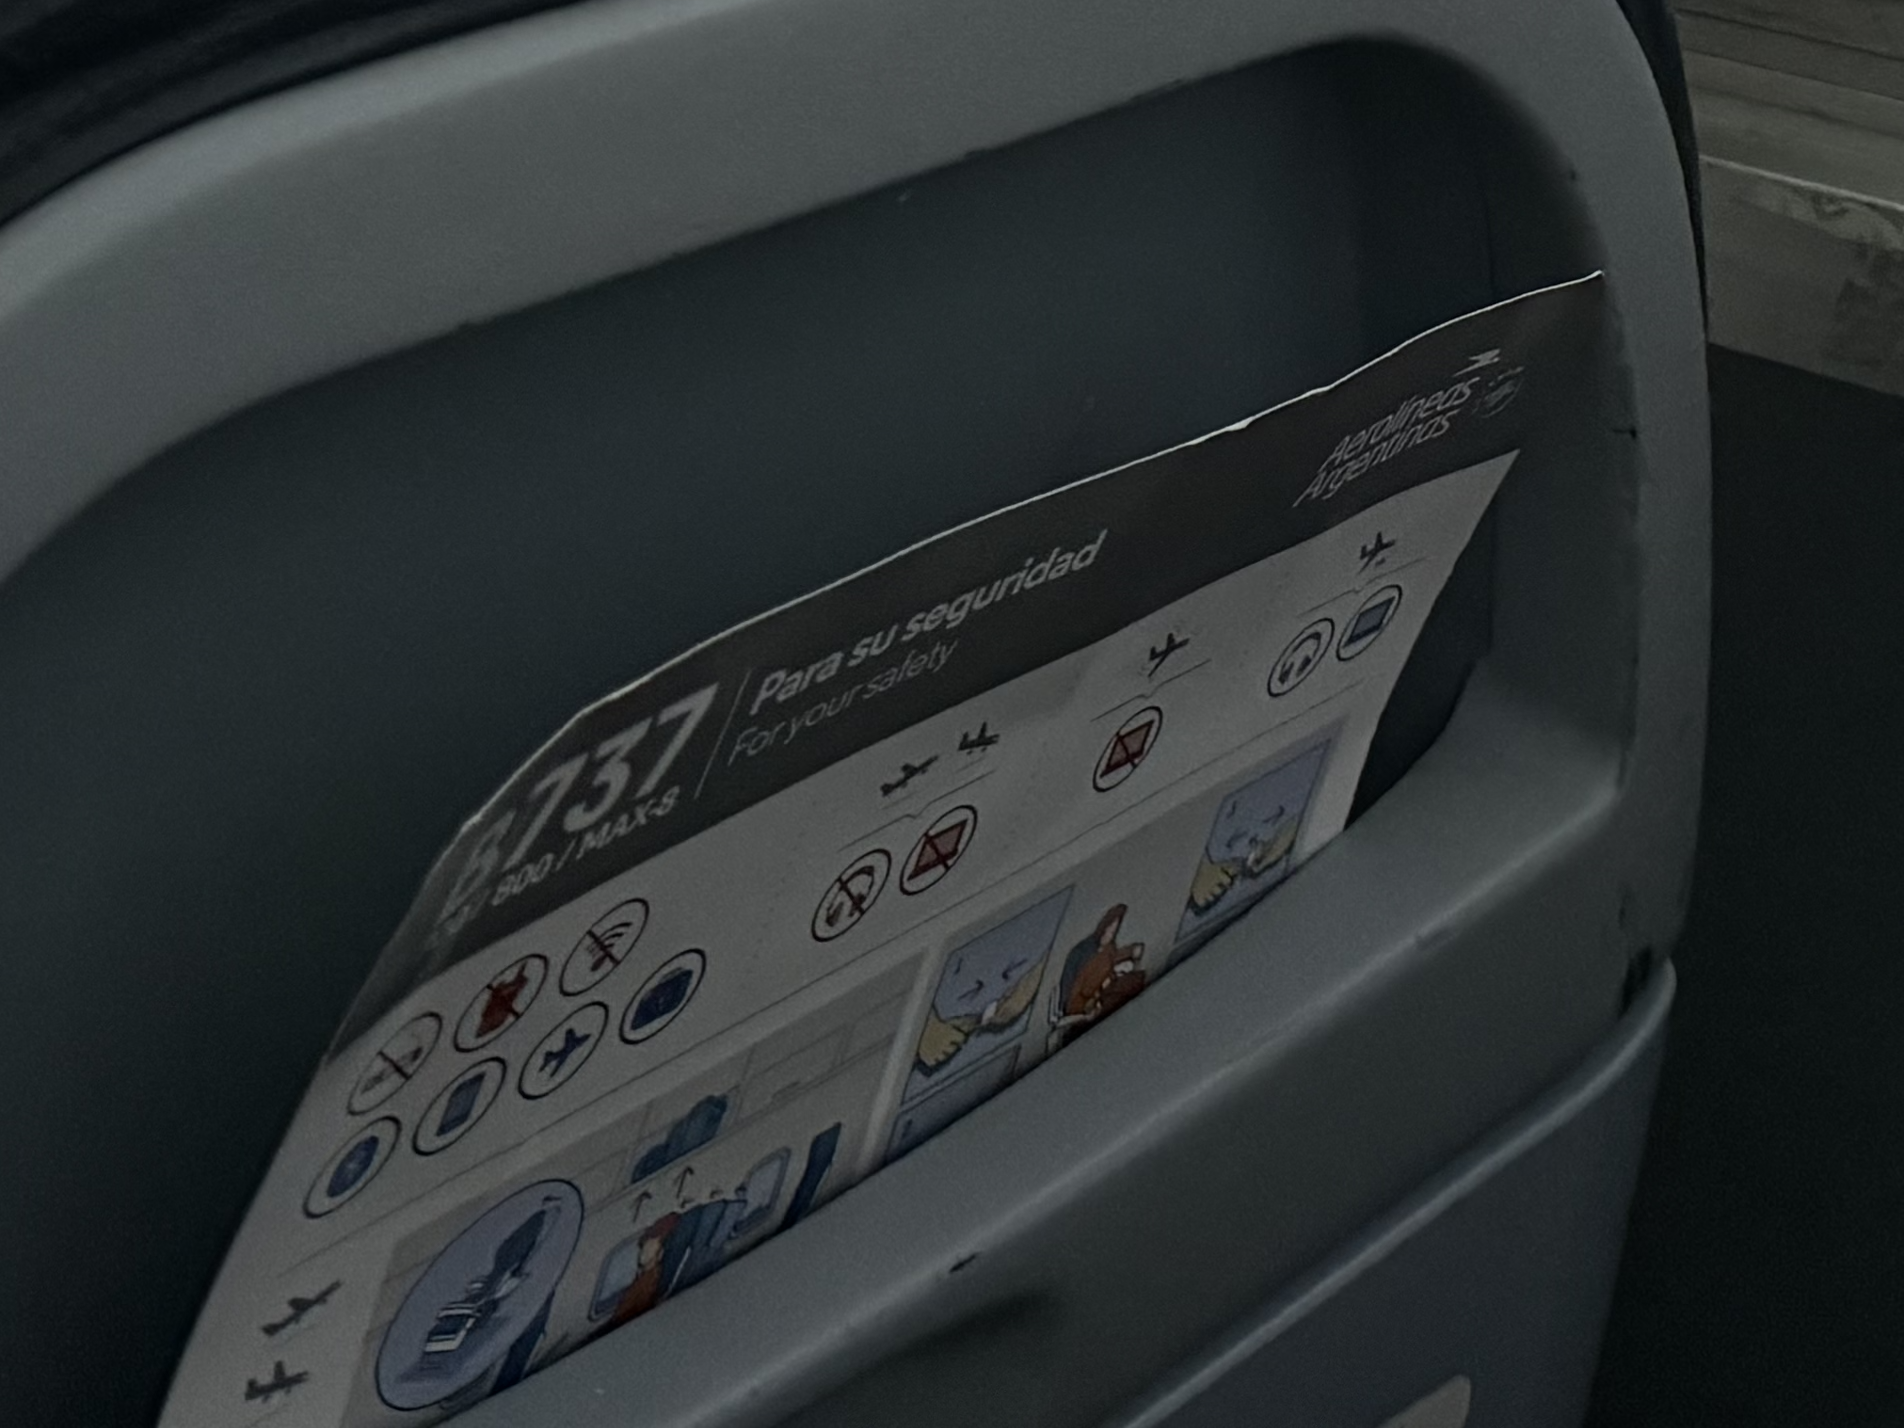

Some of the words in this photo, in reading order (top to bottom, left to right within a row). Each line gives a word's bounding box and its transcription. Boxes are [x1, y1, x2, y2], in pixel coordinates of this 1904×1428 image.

[1292, 411, 1459, 507] Argentinas
[750, 654, 844, 717] Para
[848, 624, 899, 667] su
[900, 528, 1108, 642] seguridad
[727, 725, 786, 768] For
[782, 691, 863, 750] your
[860, 638, 960, 700] safety
[439, 682, 720, 914] B737
[492, 852, 555, 907] 800
[580, 786, 681, 860] MAX-8
